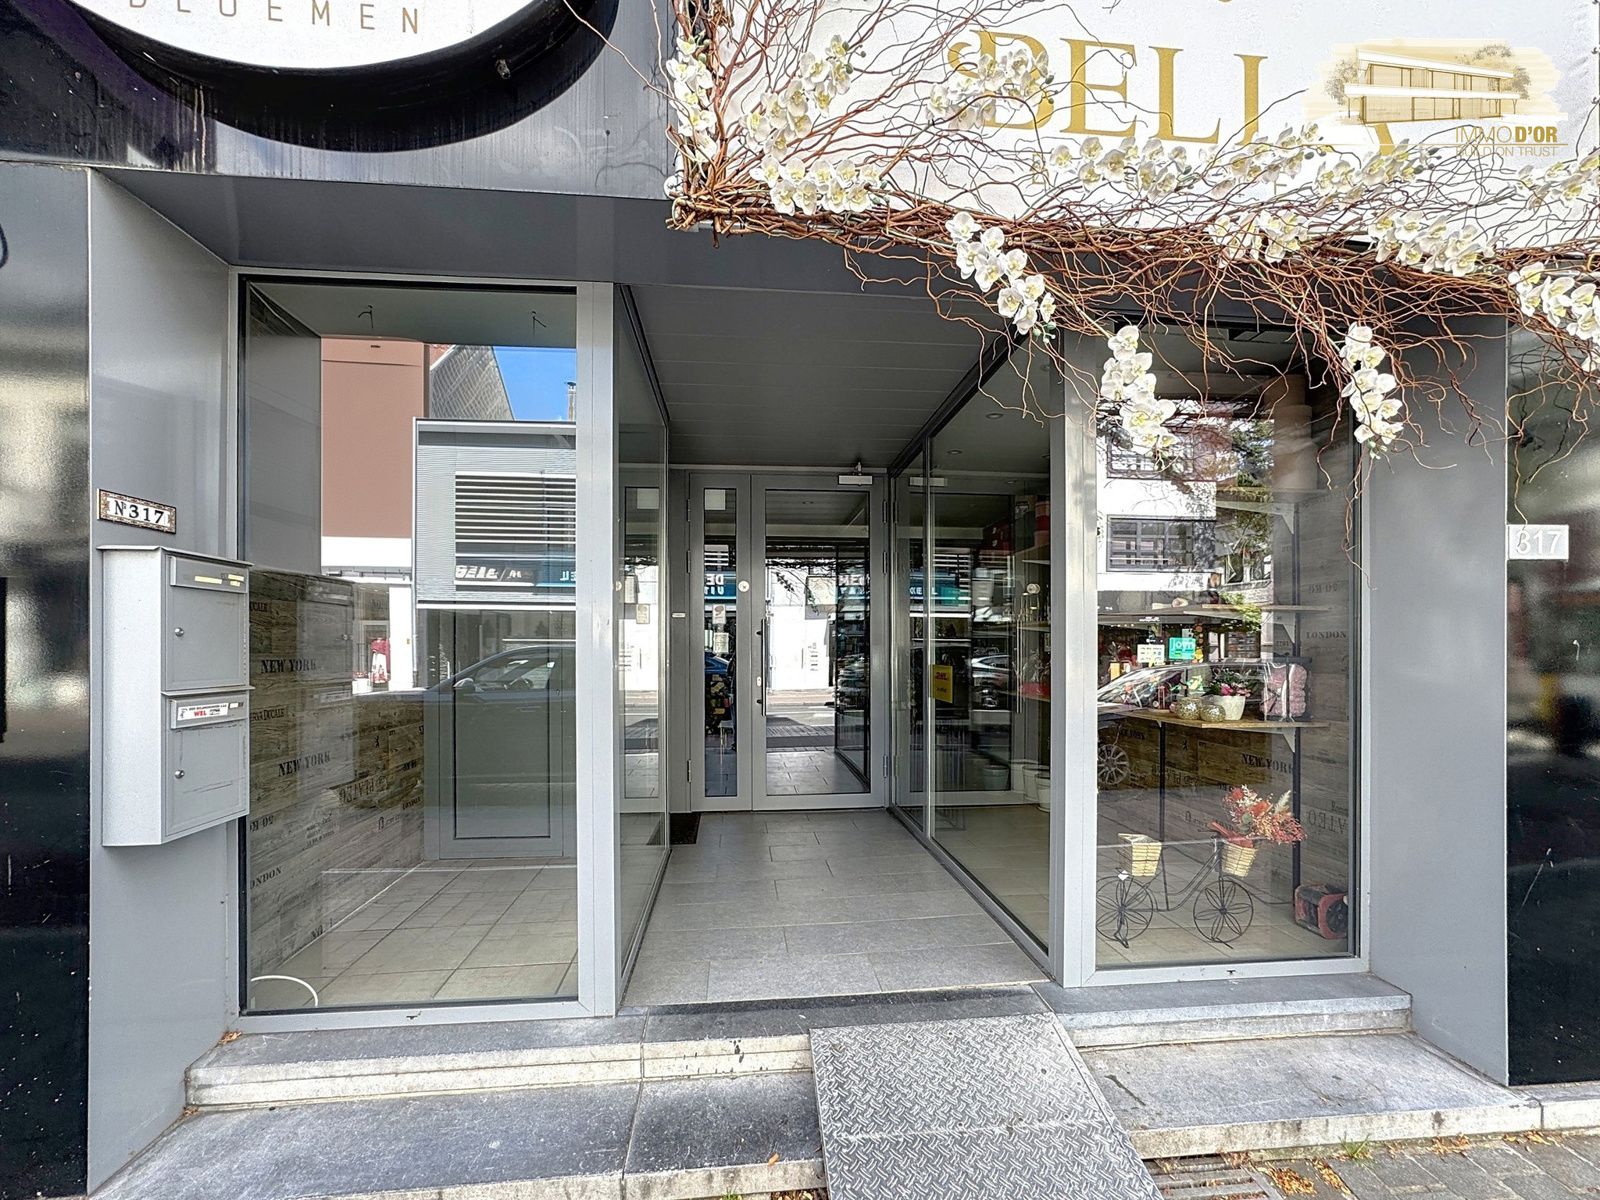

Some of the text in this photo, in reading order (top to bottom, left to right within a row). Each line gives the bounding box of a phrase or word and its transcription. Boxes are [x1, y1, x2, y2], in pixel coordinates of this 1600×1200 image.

[129, 0, 419, 34] OEMEN
[1516, 528, 1563, 555] 317
[1306, 631, 1347, 639] LONDON
[260, 657, 317, 674] NEW YORK
[278, 751, 331, 777] NEW YORK
[1241, 753, 1265, 766] NEW
